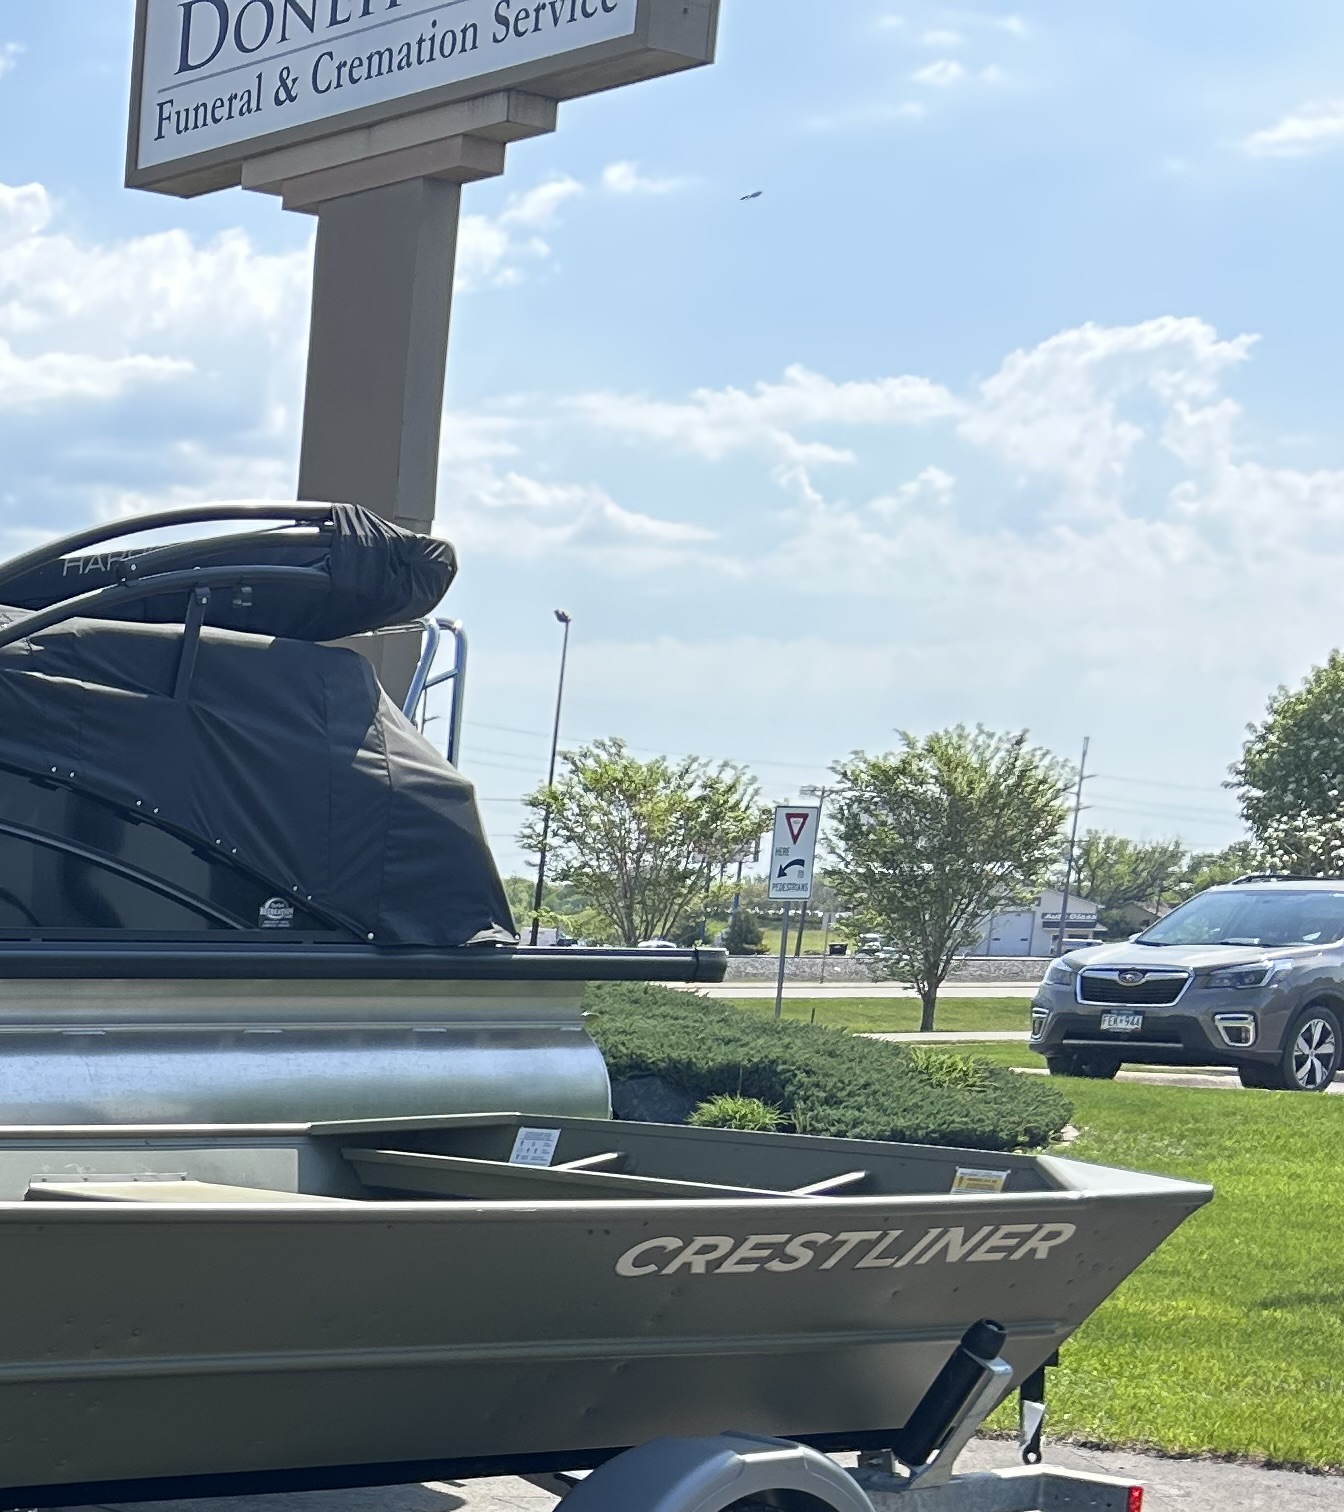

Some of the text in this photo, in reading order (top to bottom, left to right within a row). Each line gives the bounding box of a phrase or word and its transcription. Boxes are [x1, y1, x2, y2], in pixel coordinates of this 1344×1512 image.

[153, 72, 263, 141] Funeral
[273, 66, 299, 106] &
[311, 19, 480, 95] Cremation
[614, 1222, 1077, 1277] CRESTLINER
